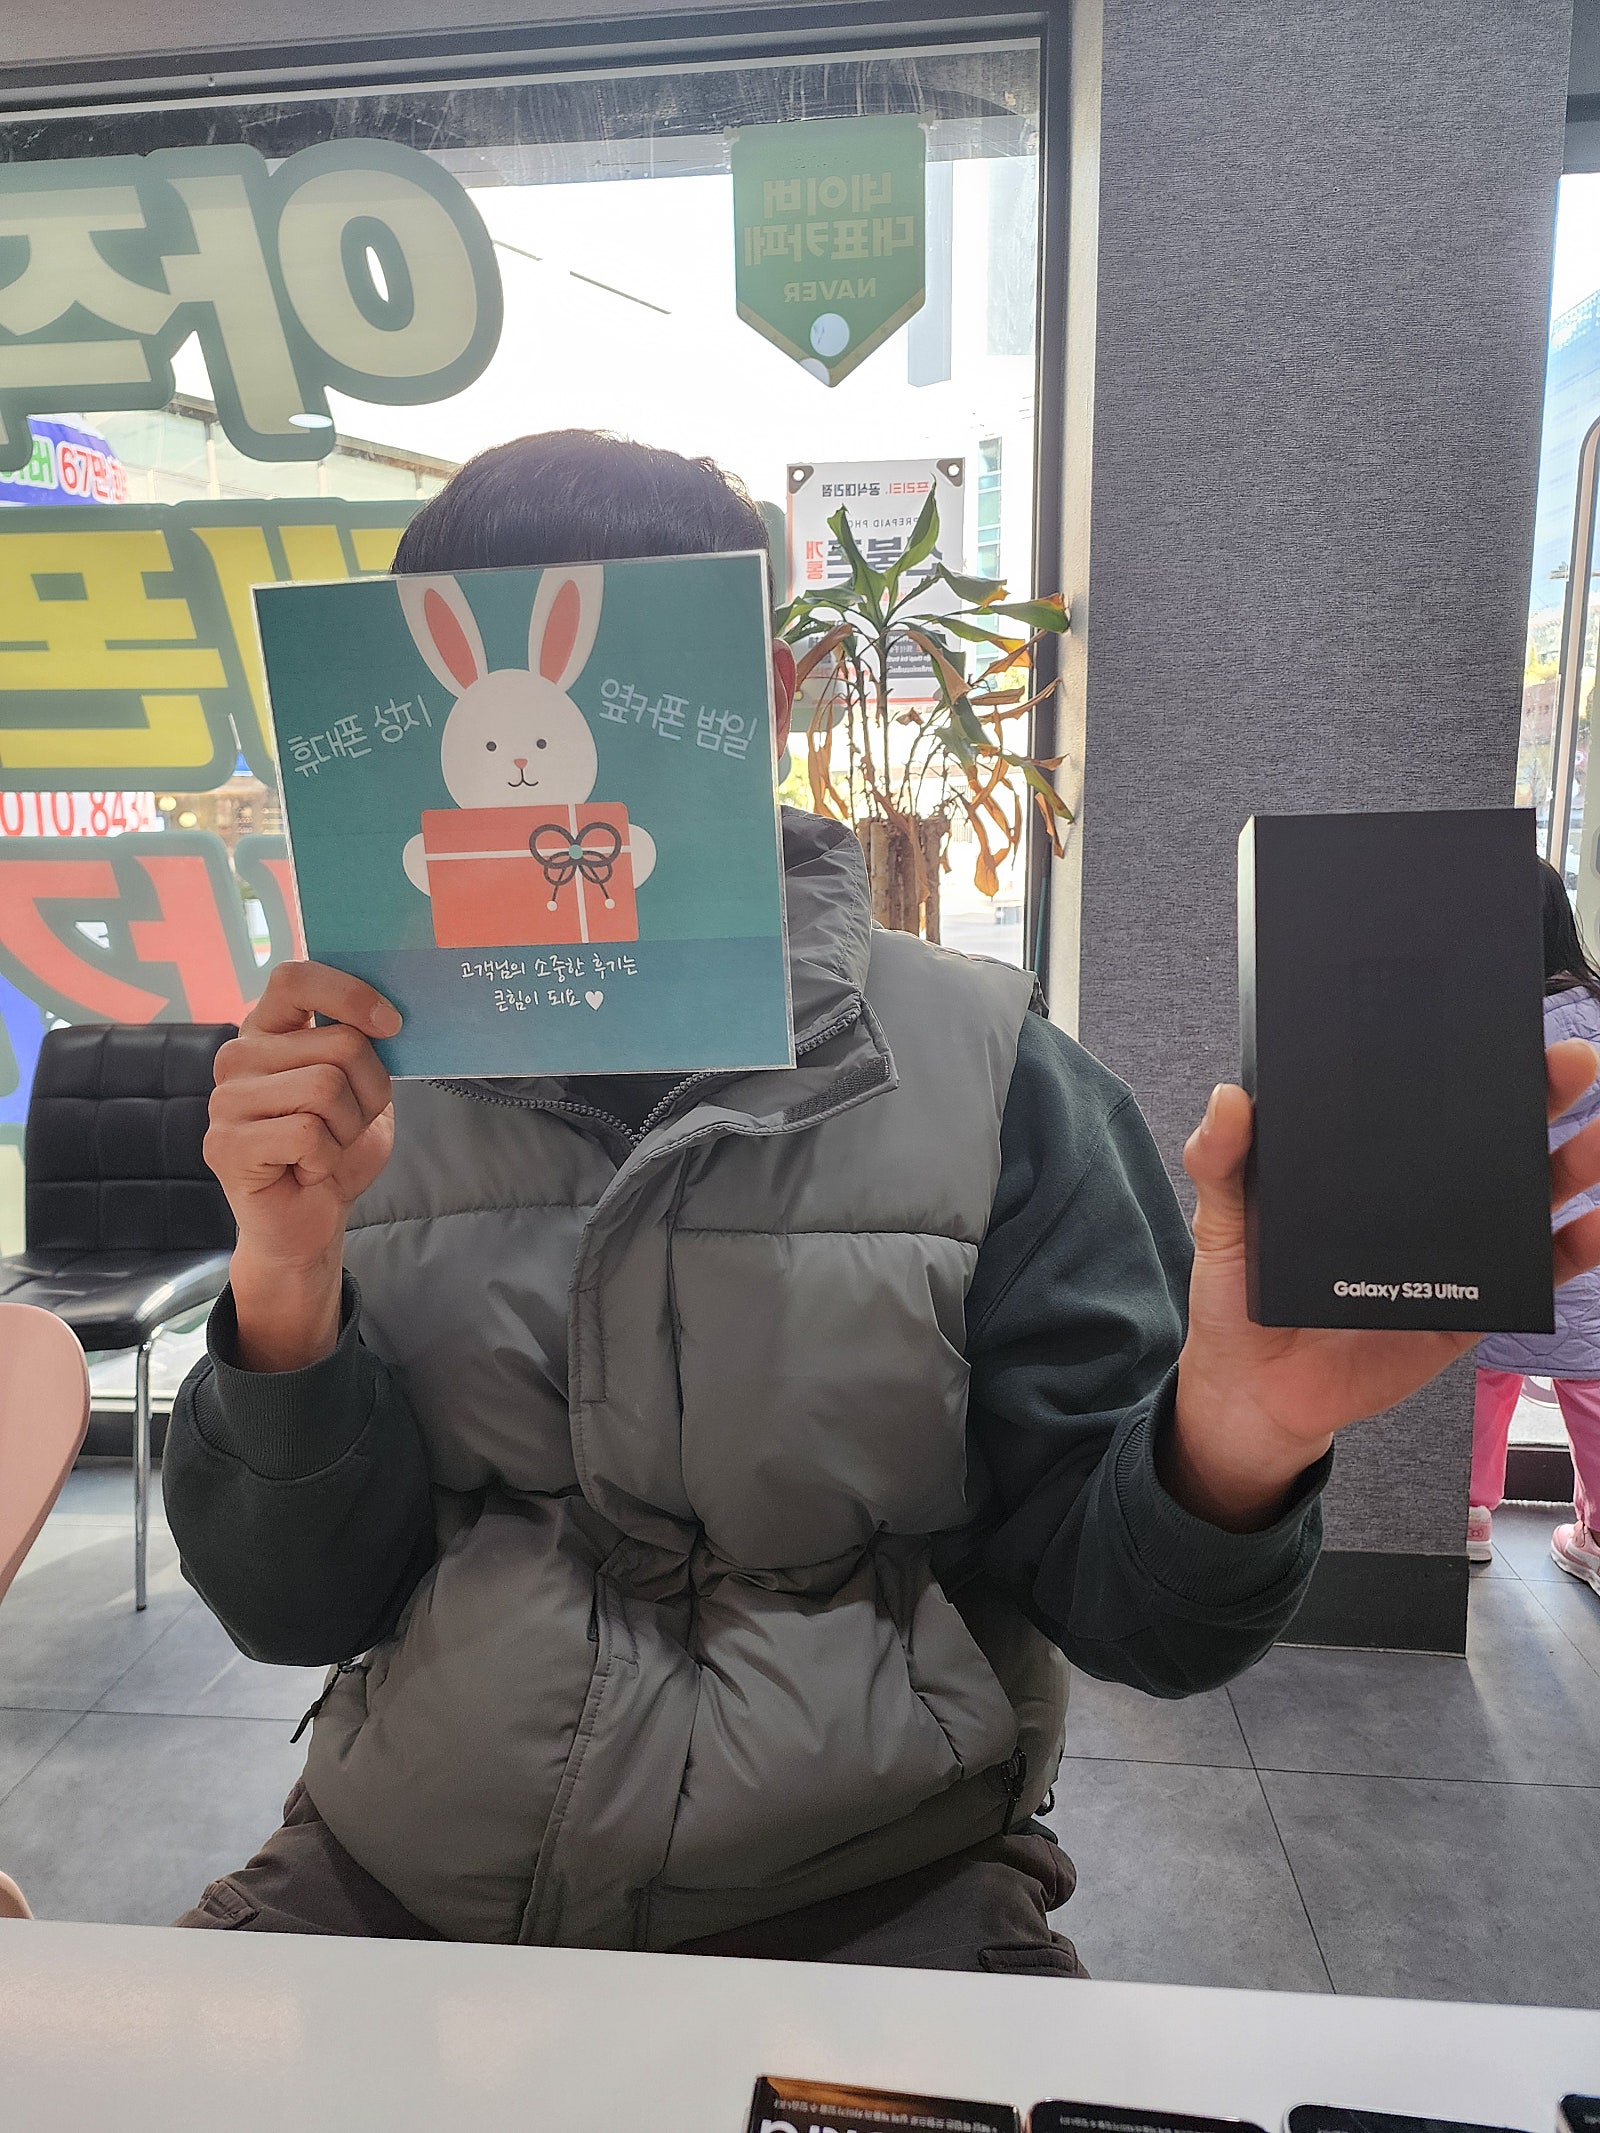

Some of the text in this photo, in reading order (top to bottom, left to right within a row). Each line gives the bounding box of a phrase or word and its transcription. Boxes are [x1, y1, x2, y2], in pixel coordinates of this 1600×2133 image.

[600, 678, 759, 761] 옆커폰 범일
[288, 694, 433, 778] 휴대폰 성지
[460, 953, 639, 983] 고객님의 소중한 후기는
[547, 987, 581, 1007] 되요
[1333, 1280, 1480, 1302] Galaxy S23 Ultra
